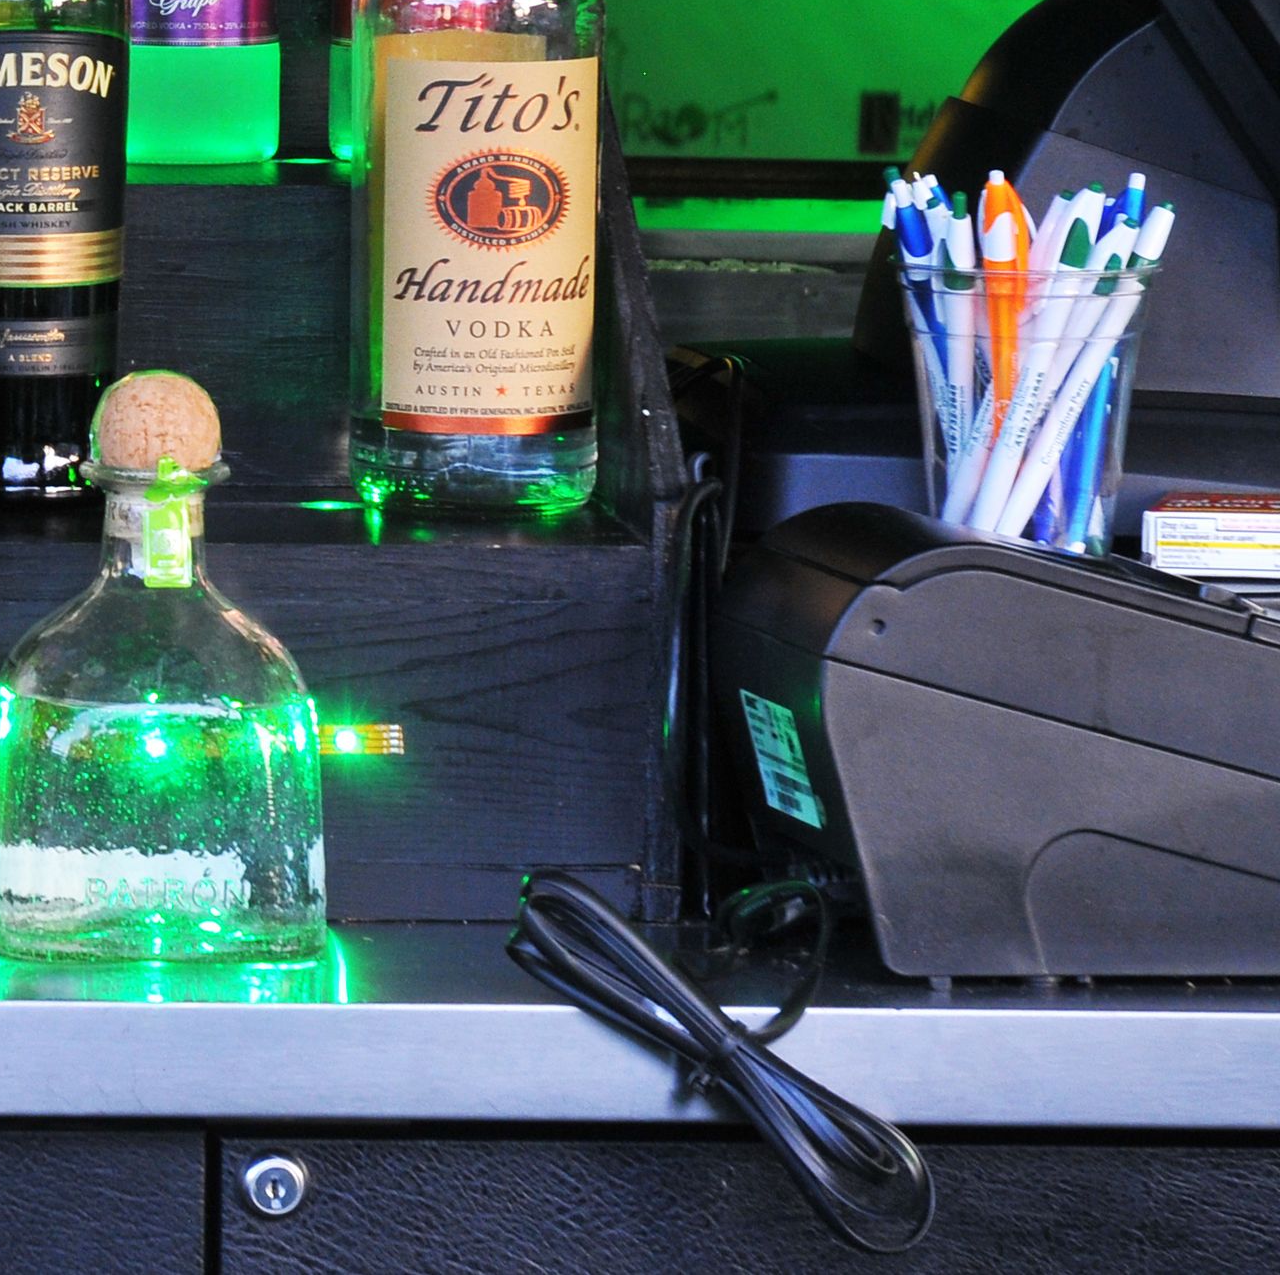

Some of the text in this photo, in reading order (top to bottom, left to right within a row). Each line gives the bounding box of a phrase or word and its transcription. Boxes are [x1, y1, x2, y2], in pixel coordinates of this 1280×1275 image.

[415, 72, 580, 133] Tito's
[457, 154, 547, 174] AWARD WINNING
[27, 166, 99, 181] RESERVE
[28, 201, 79, 213] BARREL
[451, 223, 550, 245] DISTILLED TIMES
[393, 255, 590, 304] Handmade
[445, 320, 555, 338] VODKA
[415, 346, 544, 360] Crafted an Old Fashioned
[413, 361, 424, 373] by
[426, 360, 472, 372] America's
[475, 362, 517, 377] Original
[415, 385, 576, 396] AUSTIN TEXAS
